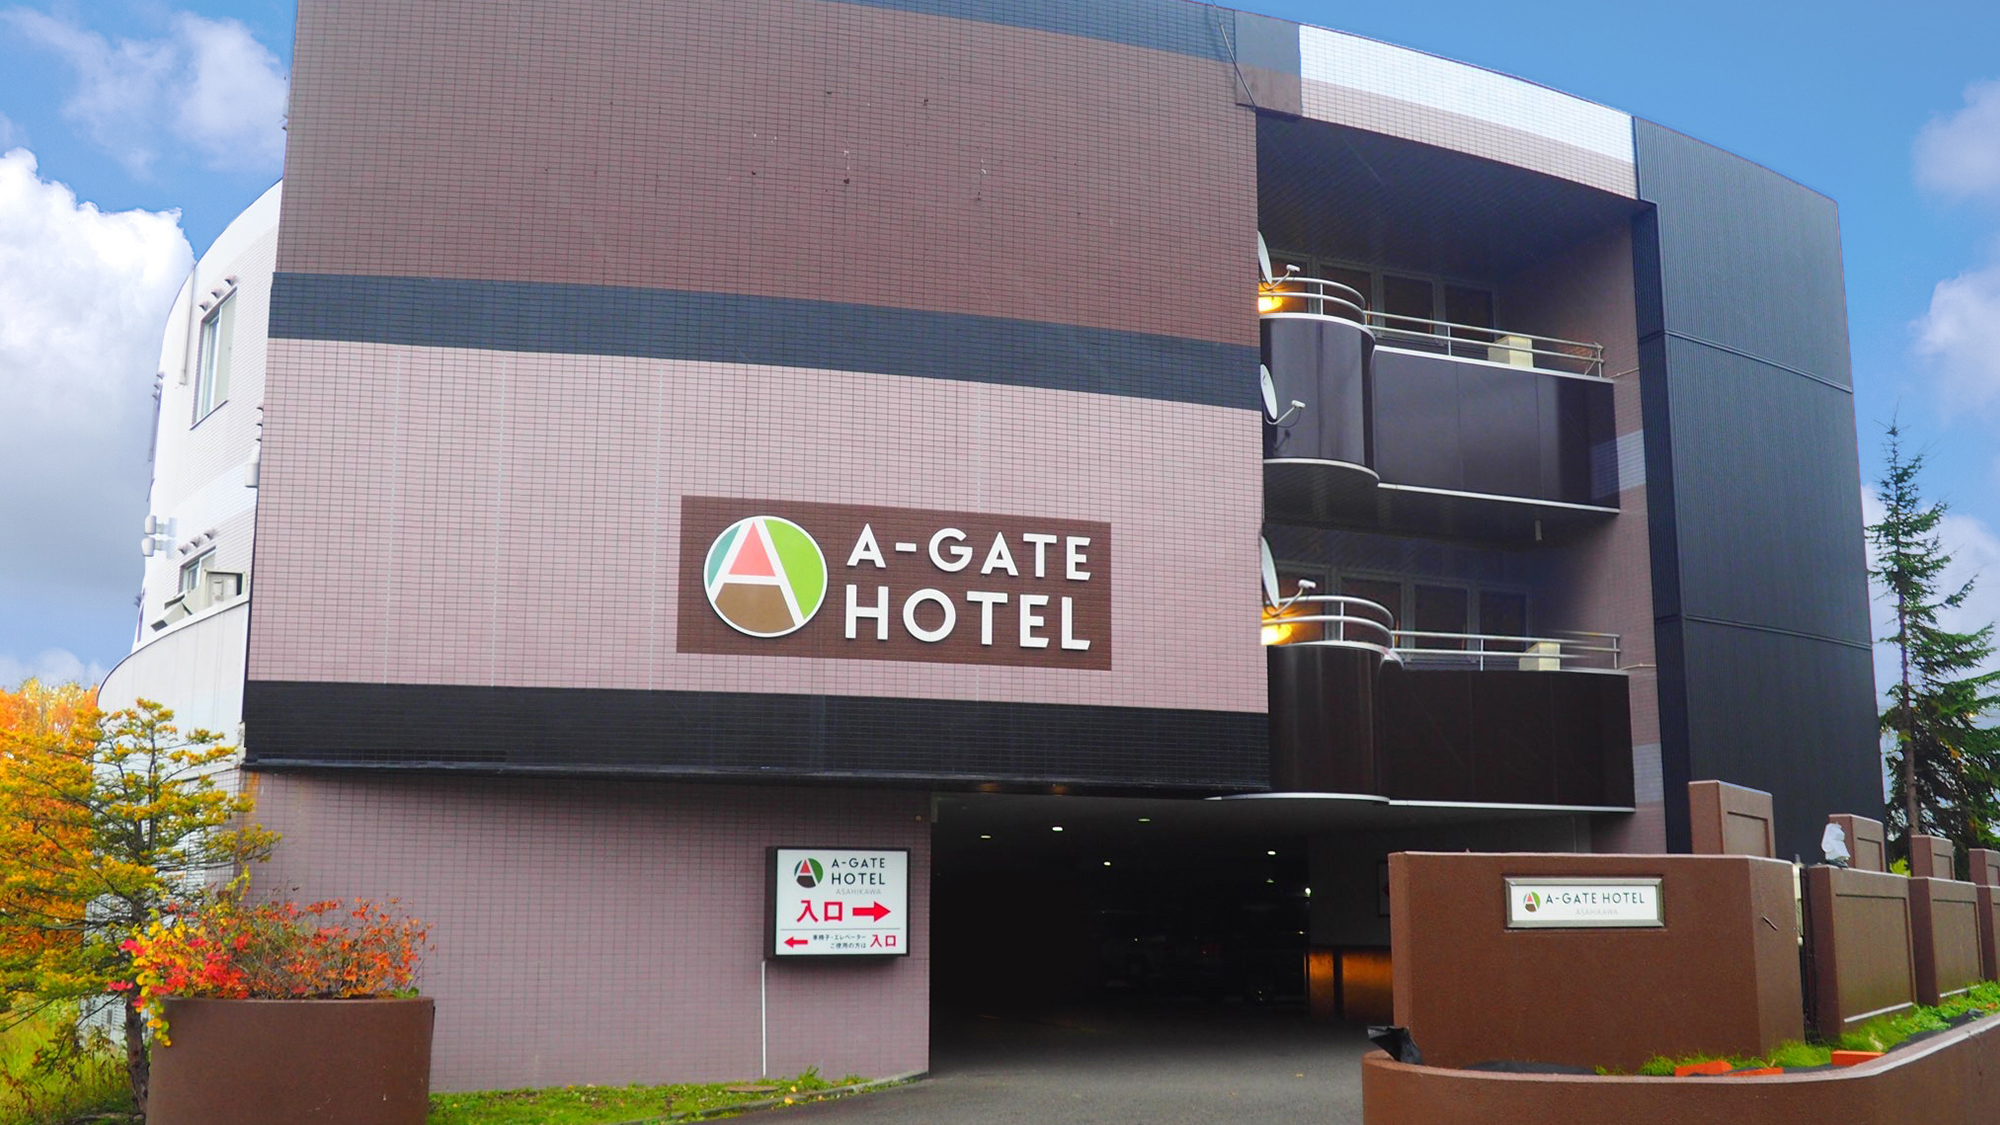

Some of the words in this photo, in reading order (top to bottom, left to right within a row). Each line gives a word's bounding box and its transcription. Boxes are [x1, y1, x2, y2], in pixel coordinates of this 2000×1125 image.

[846, 523, 1091, 581] A-GATE
[845, 584, 1091, 650] HOTEL
[831, 857, 885, 868] A-GATE
[831, 873, 885, 885] HOTEL
[1546, 892, 1597, 904] A-GATE
[1602, 892, 1645, 904] HOTEL
[796, 900, 843, 923] 入口
[870, 934, 896, 948] 入口
